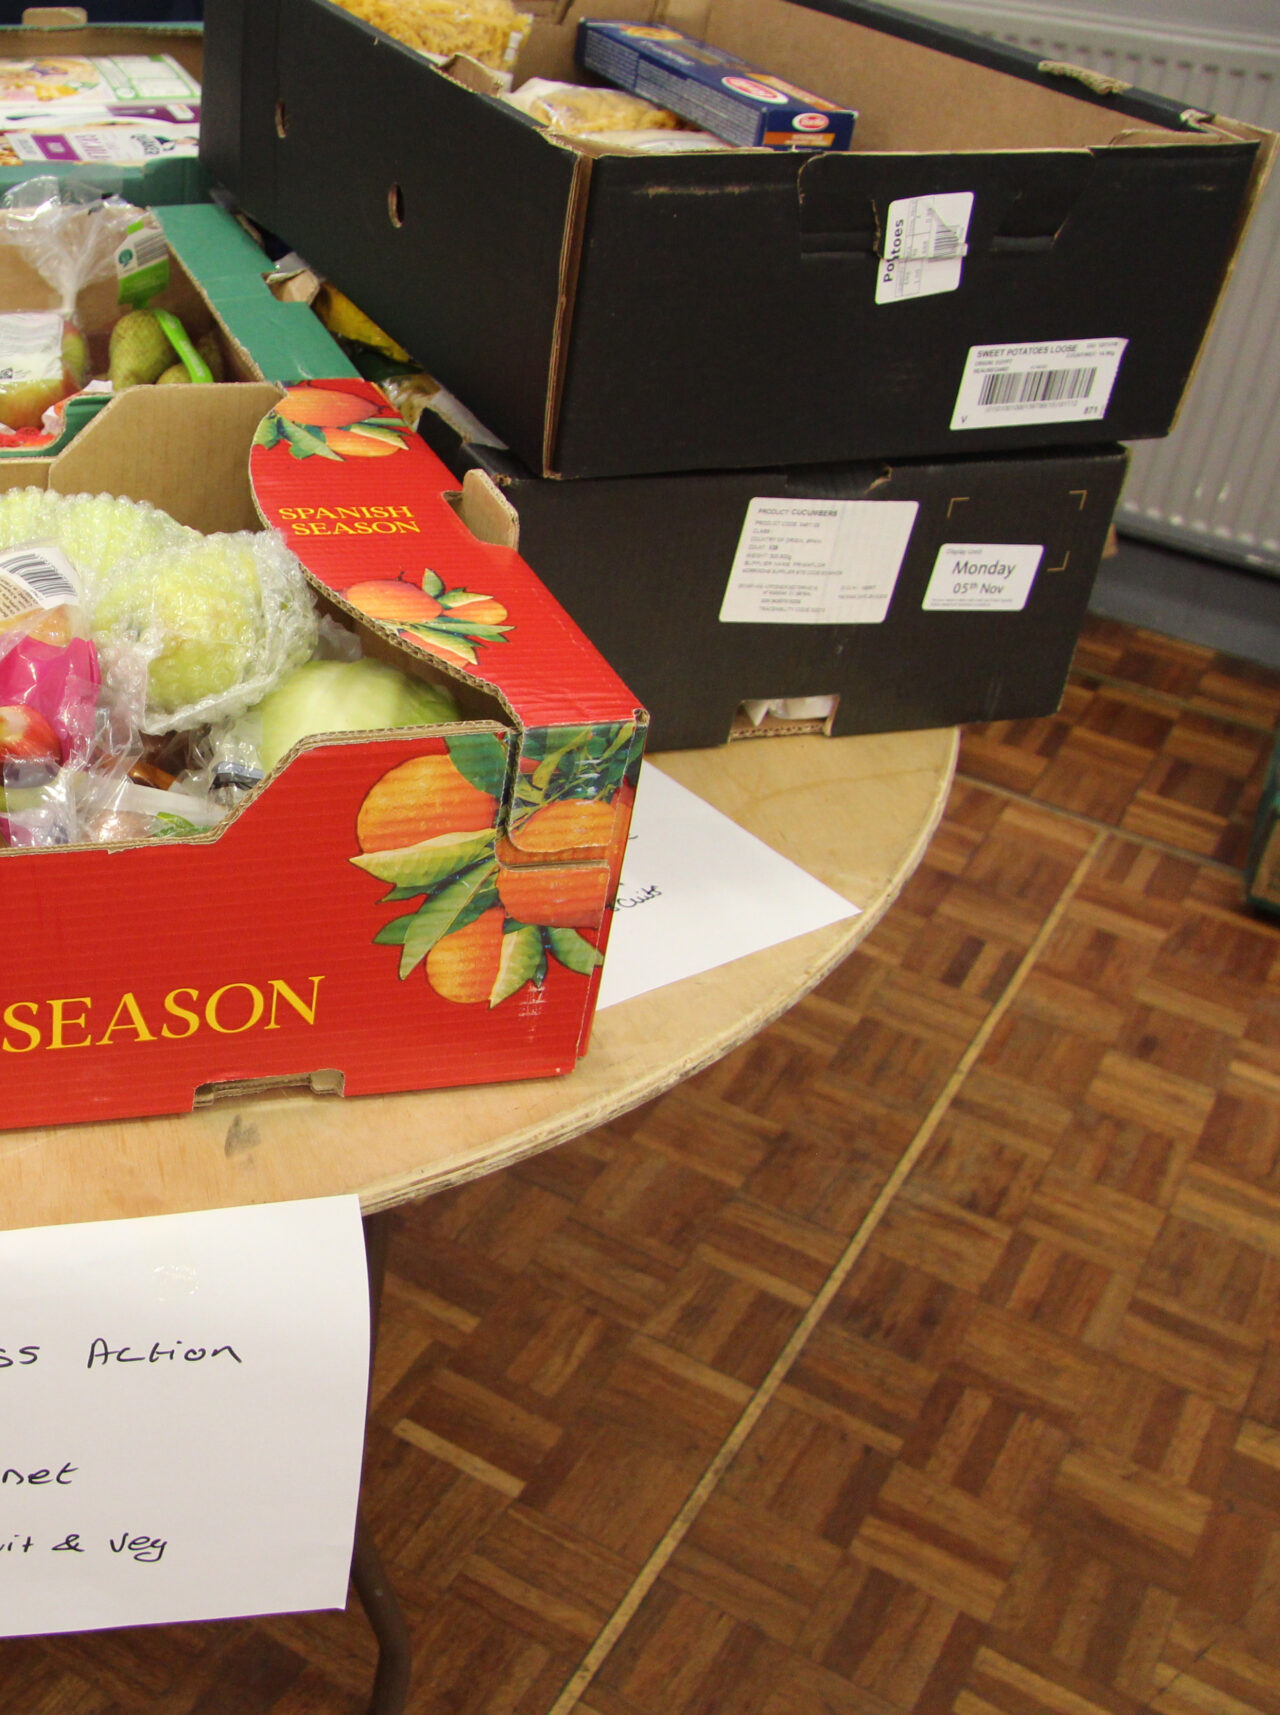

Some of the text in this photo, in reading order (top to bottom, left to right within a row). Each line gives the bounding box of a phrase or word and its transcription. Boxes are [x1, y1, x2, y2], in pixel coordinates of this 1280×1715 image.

[977, 349, 1005, 358] SWEET
[1007, 347, 1049, 357] POTATOES
[278, 506, 415, 520] SPANISH
[291, 521, 421, 536] SEASON
[952, 560, 1016, 579] Monday
[980, 583, 1004, 594] Nov
[2, 975, 325, 1053] SEASON
[86, 1338, 243, 1371] Action
[53, 1533, 84, 1554] &
